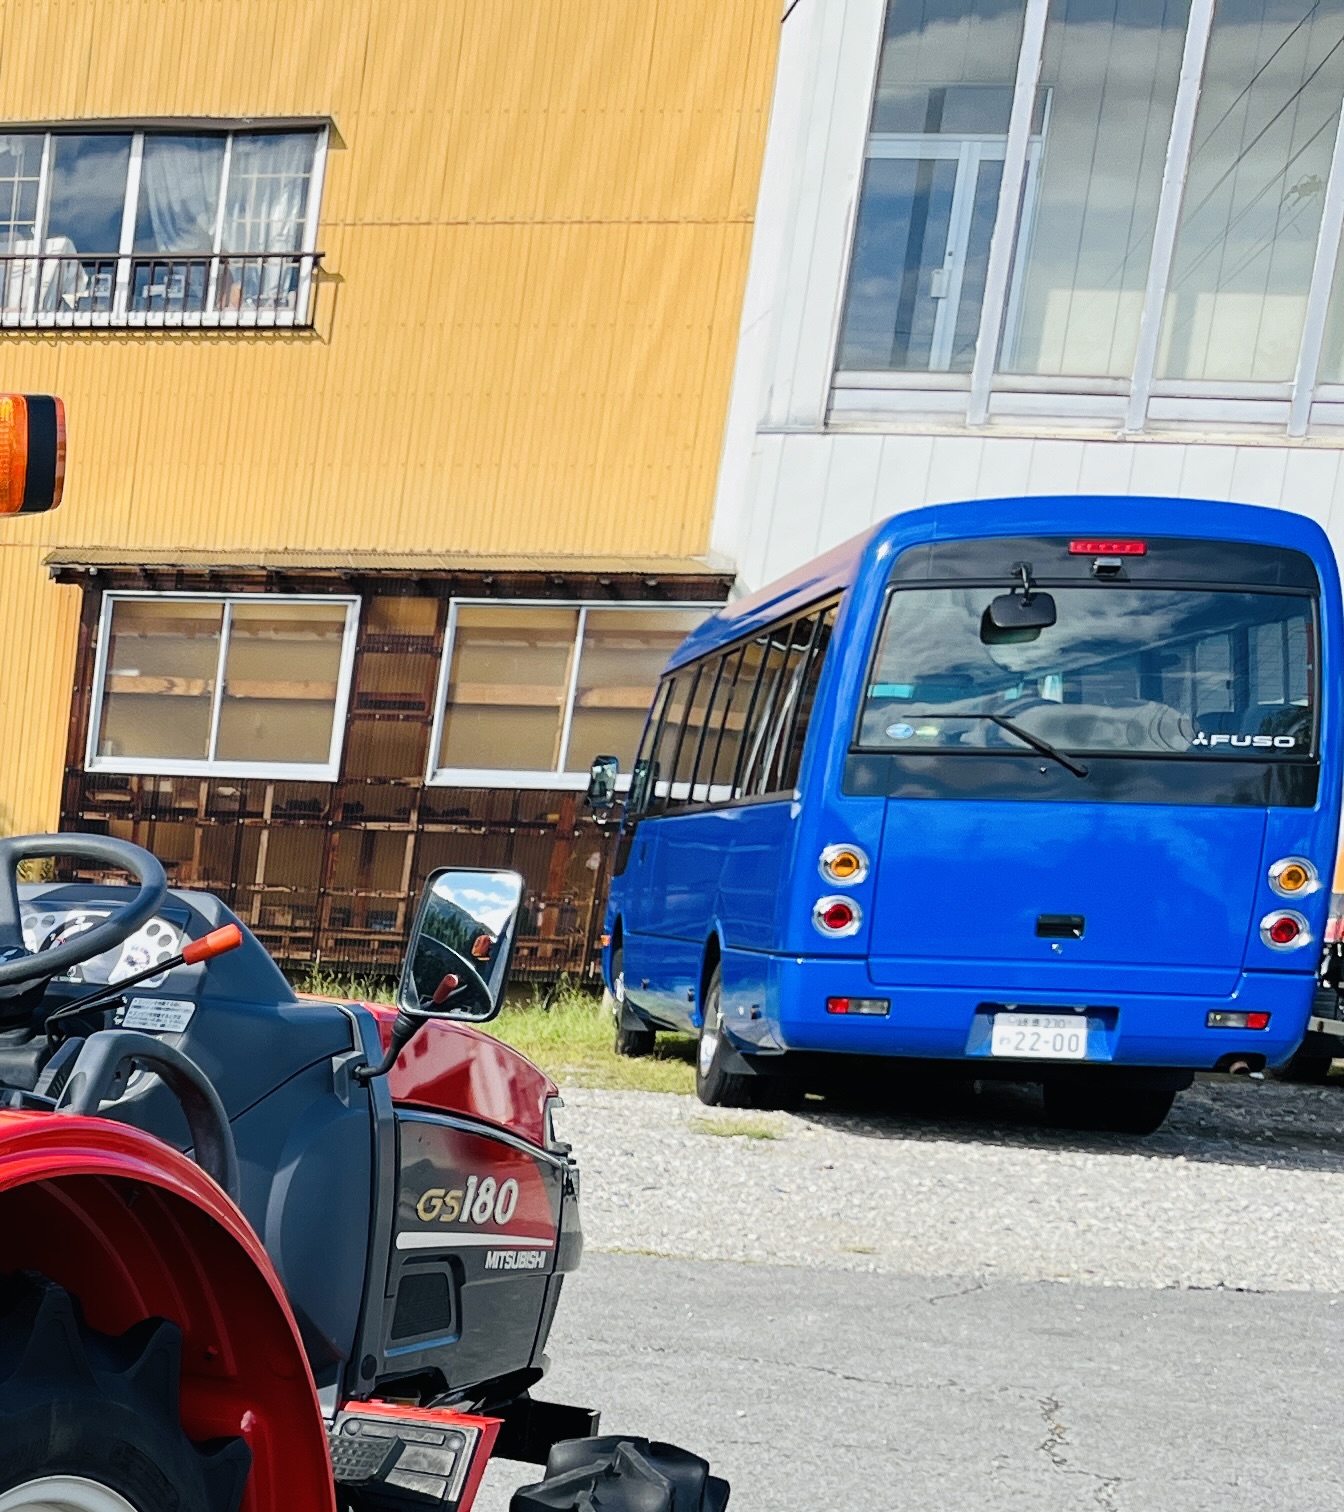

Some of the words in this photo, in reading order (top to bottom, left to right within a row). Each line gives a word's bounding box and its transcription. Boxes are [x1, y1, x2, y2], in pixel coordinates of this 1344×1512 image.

[1210, 733, 1296, 748] FUSO
[1014, 1031, 1080, 1053] 22-00
[416, 1175, 520, 1226] GS180
[484, 1250, 547, 1270] MITSUBISHI
